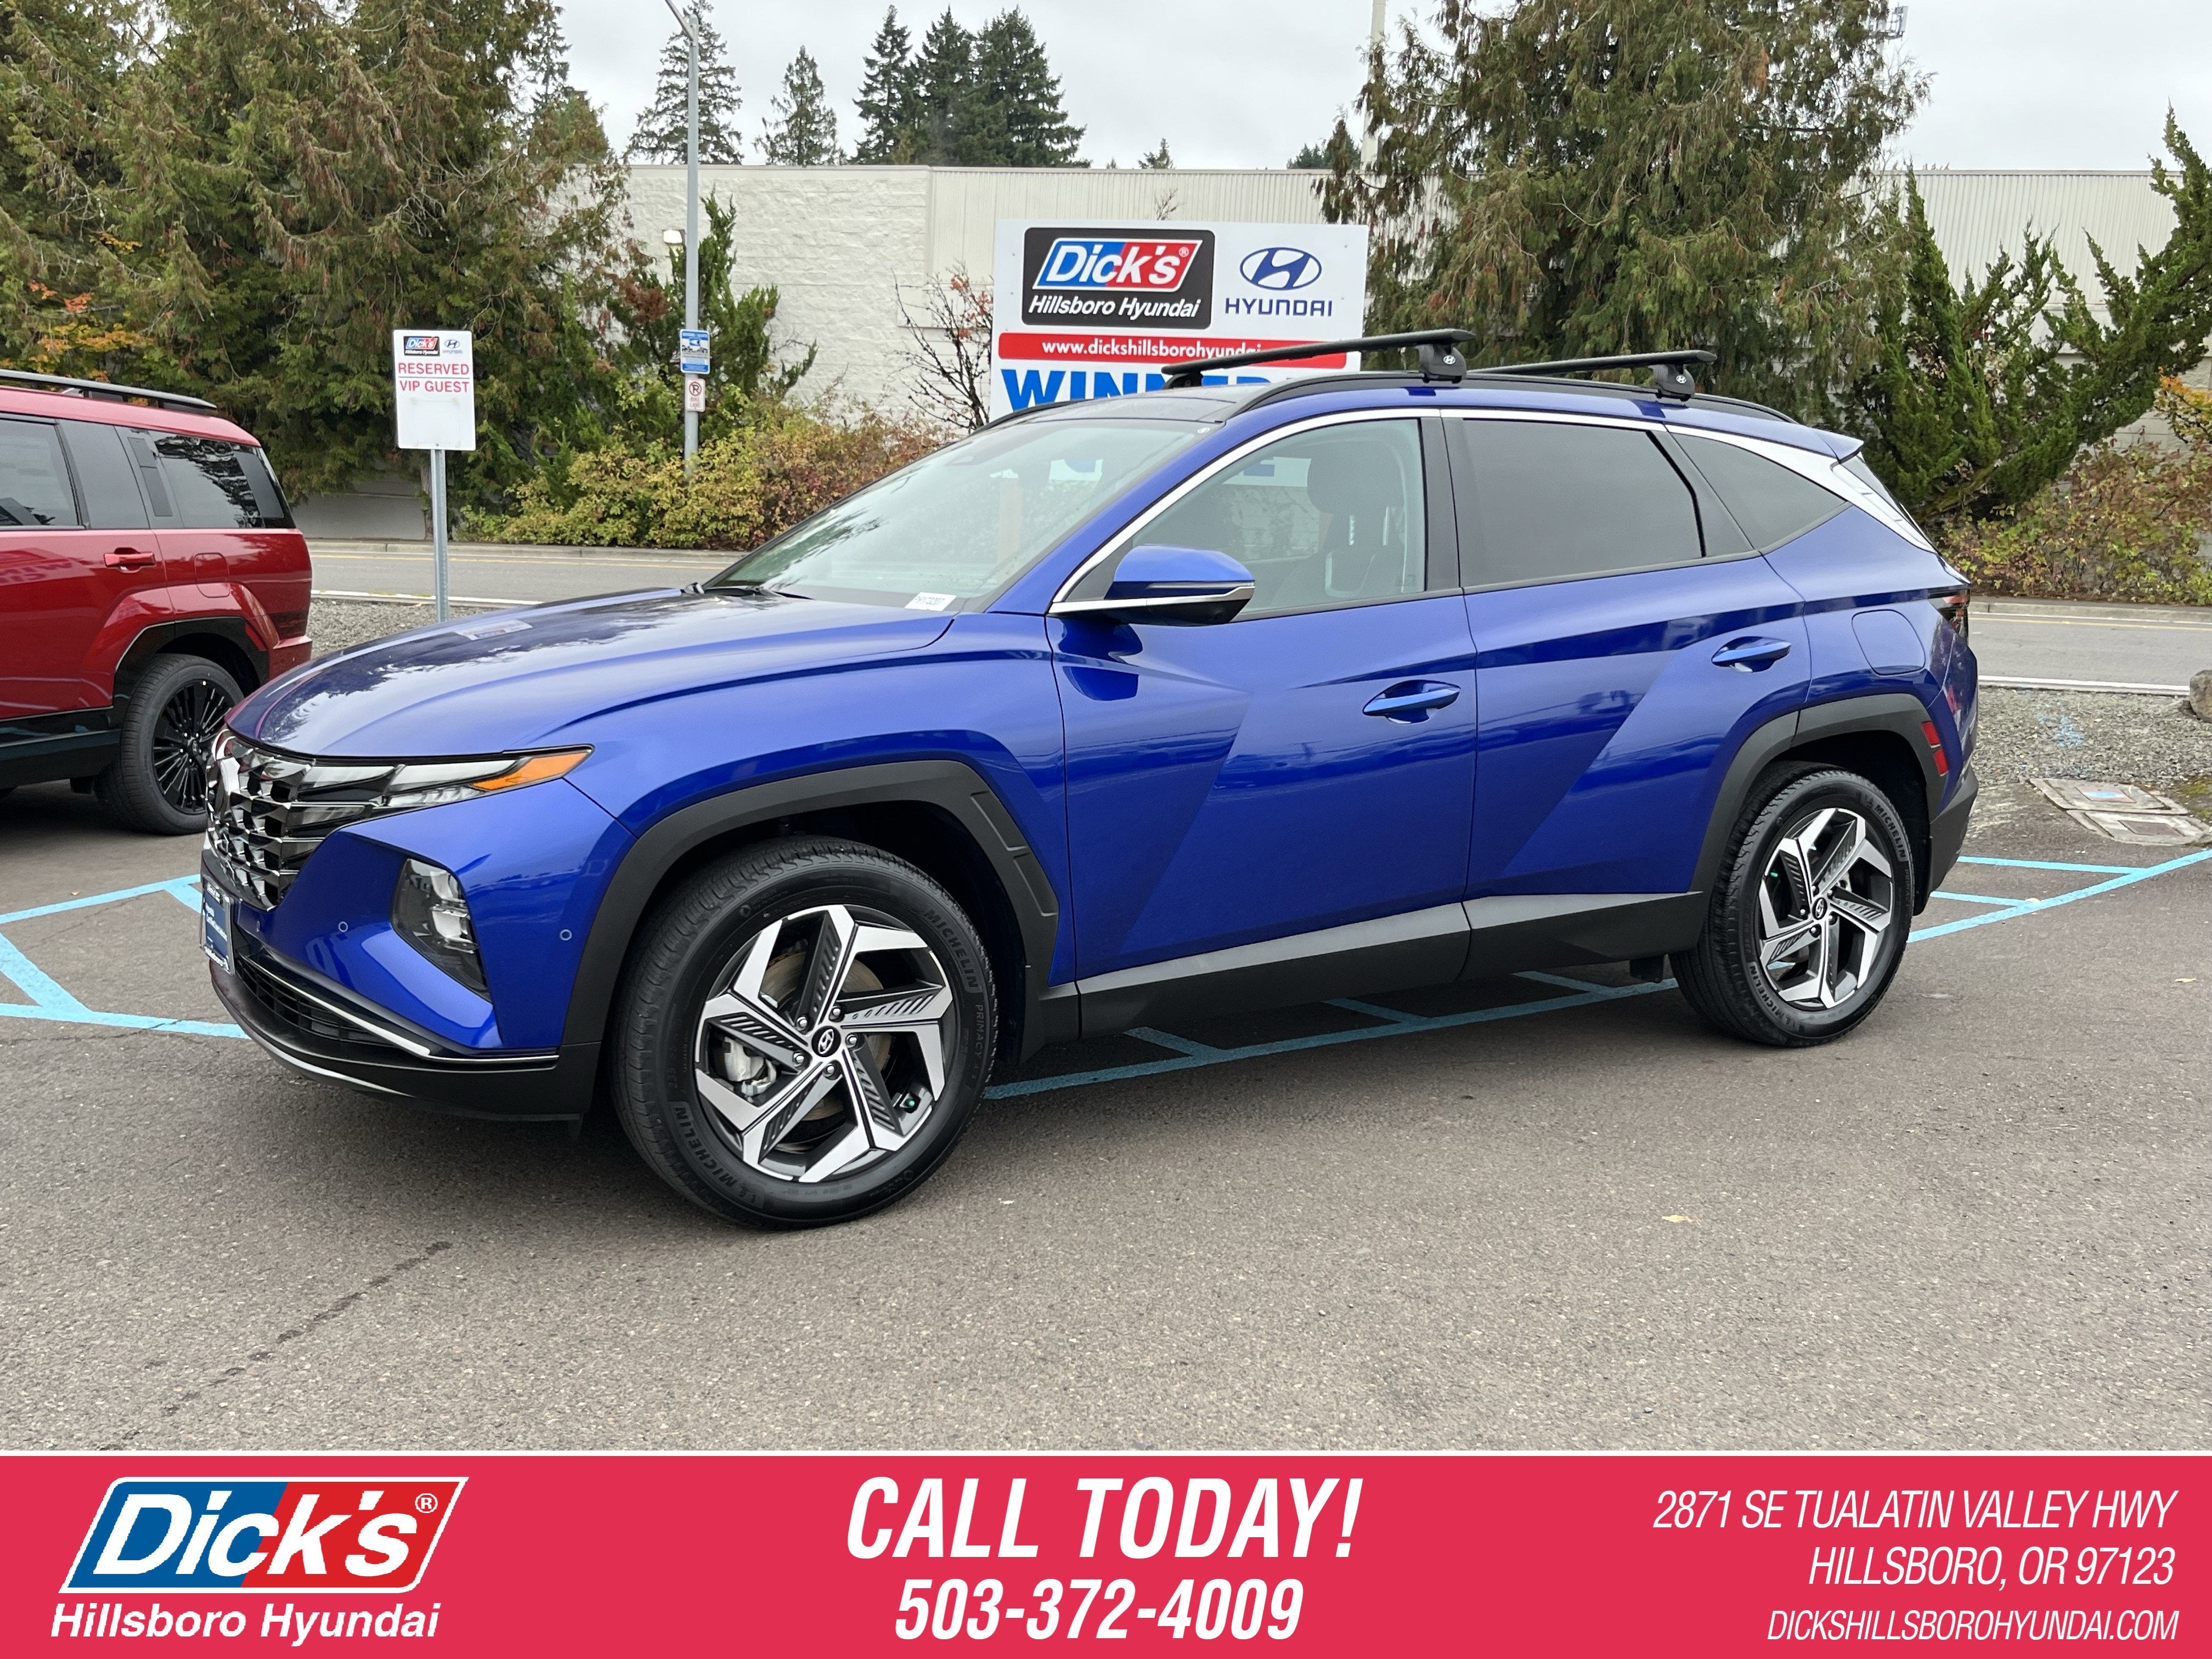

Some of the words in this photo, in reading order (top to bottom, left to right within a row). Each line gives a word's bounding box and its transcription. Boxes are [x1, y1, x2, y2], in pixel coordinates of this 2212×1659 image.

[1028, 295, 1116, 315] Hillsboro
[1118, 297, 1202, 320] Hyundai
[1225, 297, 1333, 317] HYUNDAI
[398, 362, 470, 375] RESERVED
[399, 380, 420, 392] VIP
[425, 380, 470, 393] GUEST
[1874, 804, 1906, 858] MICHELIN
[923, 909, 979, 989] MICHELIN
[1750, 965, 1785, 1019] MICHELIN
[674, 1107, 738, 1188] MICHELIN
